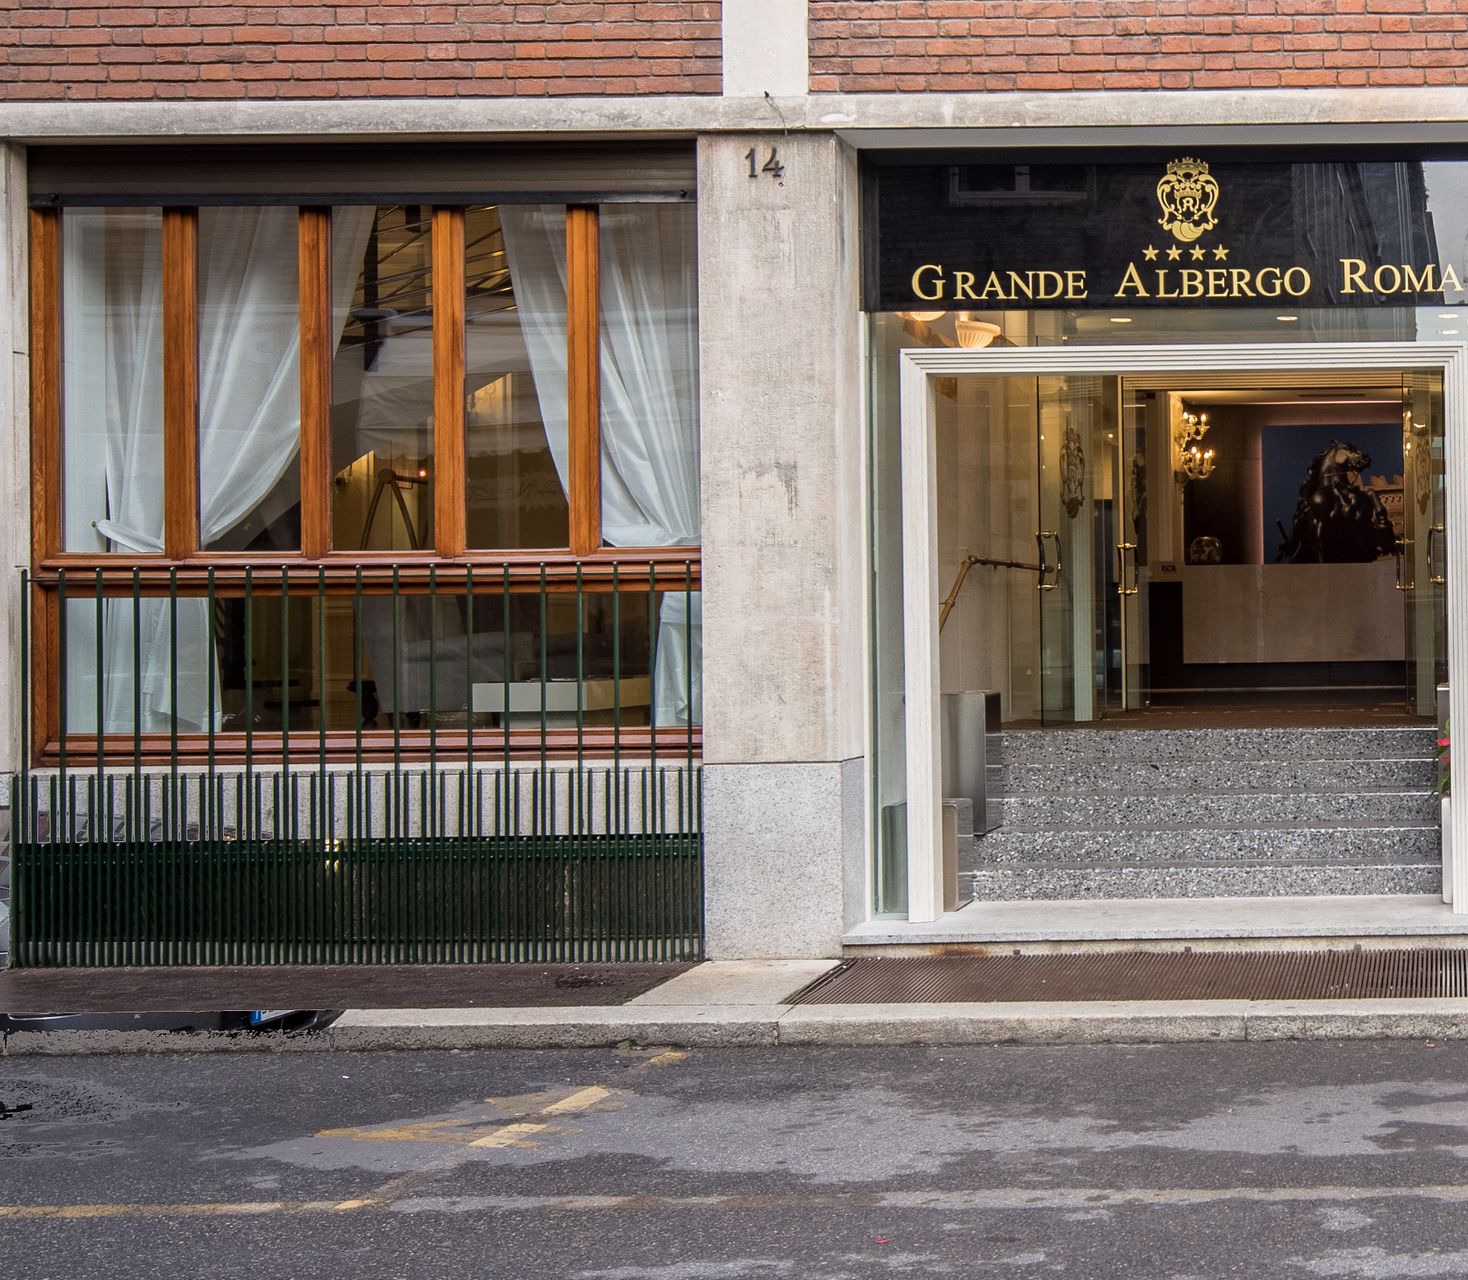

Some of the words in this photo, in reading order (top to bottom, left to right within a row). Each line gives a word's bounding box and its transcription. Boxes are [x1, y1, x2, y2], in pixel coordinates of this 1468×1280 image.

[745, 147, 785, 178] 14
[911, 264, 1088, 301] GRANDE
[1115, 261, 1312, 298] ALBERGO
[1340, 258, 1464, 294] ROMA
